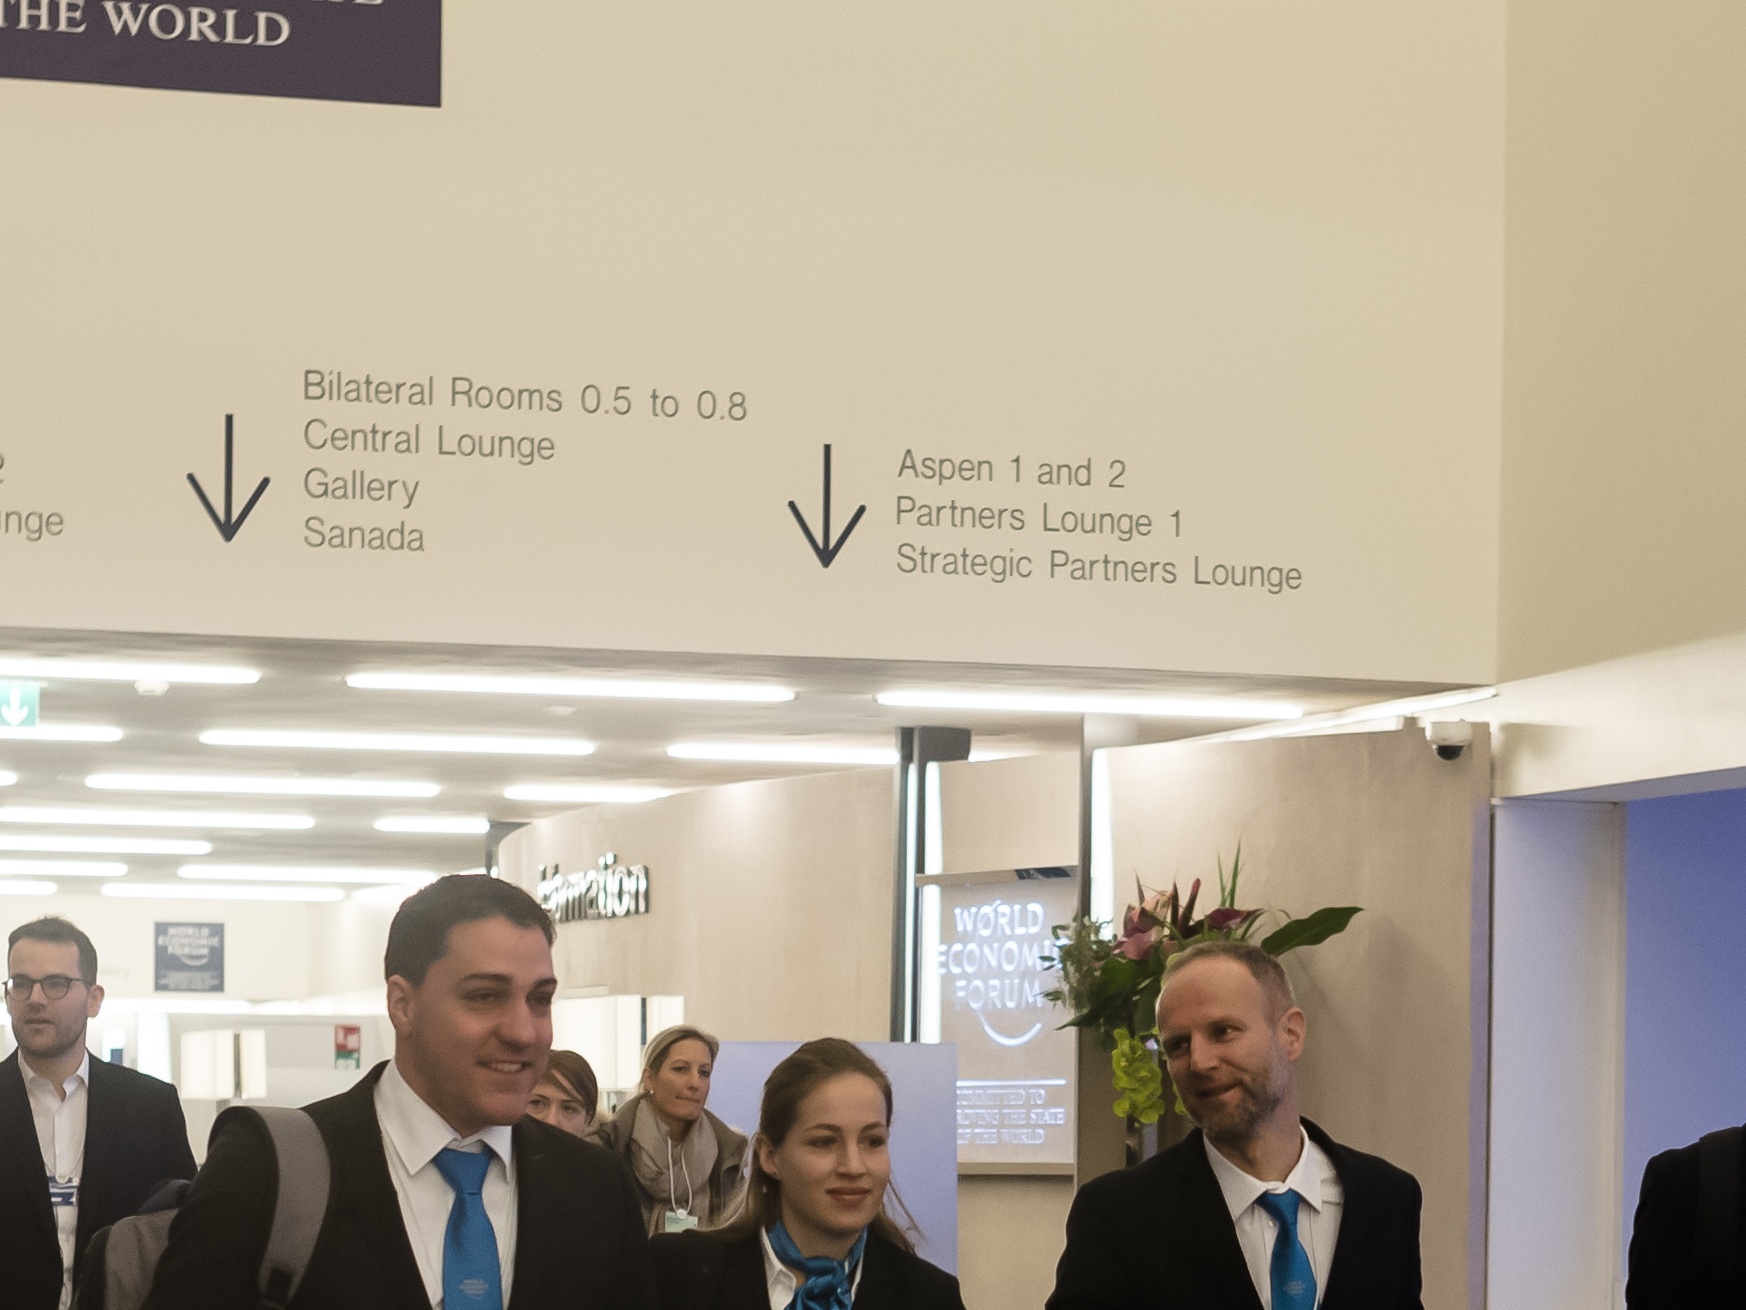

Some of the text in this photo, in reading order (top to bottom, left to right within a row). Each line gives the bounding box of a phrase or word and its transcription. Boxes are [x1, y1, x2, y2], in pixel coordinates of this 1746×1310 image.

[104, 1, 291, 46] WORLD
[303, 369, 748, 422] Bilateral Rooms 0.5 to 0.8
[303, 417, 556, 467] Central Lounge
[303, 467, 420, 510] Gallery
[896, 449, 1127, 489] Aspen 1 and 2
[0, 510, 65, 543] nge
[303, 516, 426, 553] Sanada
[896, 495, 1182, 543] Partners Lounge 1
[896, 543, 1303, 596] Strategic Partners Lounge
[954, 901, 1045, 937] WORLD
[954, 978, 1044, 1011] FORUM
